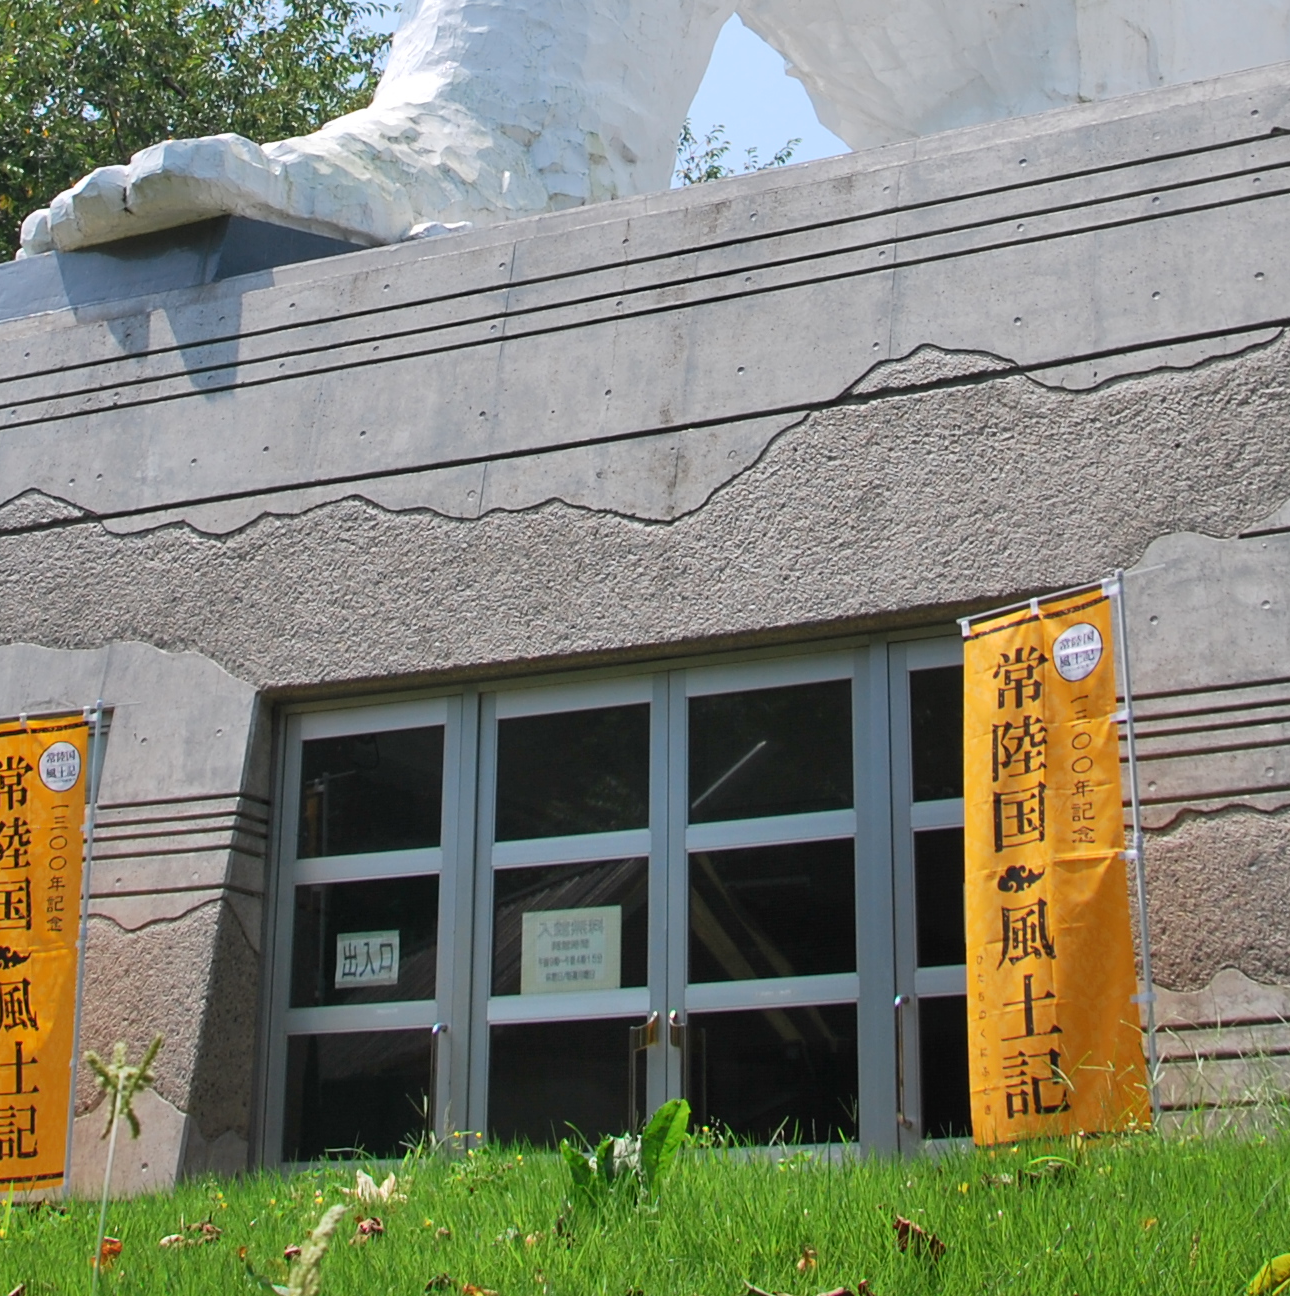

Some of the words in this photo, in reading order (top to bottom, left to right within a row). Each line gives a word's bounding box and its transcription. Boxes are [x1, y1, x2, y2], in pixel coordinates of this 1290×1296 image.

[1059, 629, 1095, 650] 常陸国
[46, 749, 76, 764] 常陸国
[341, 941, 394, 979] 出入口
